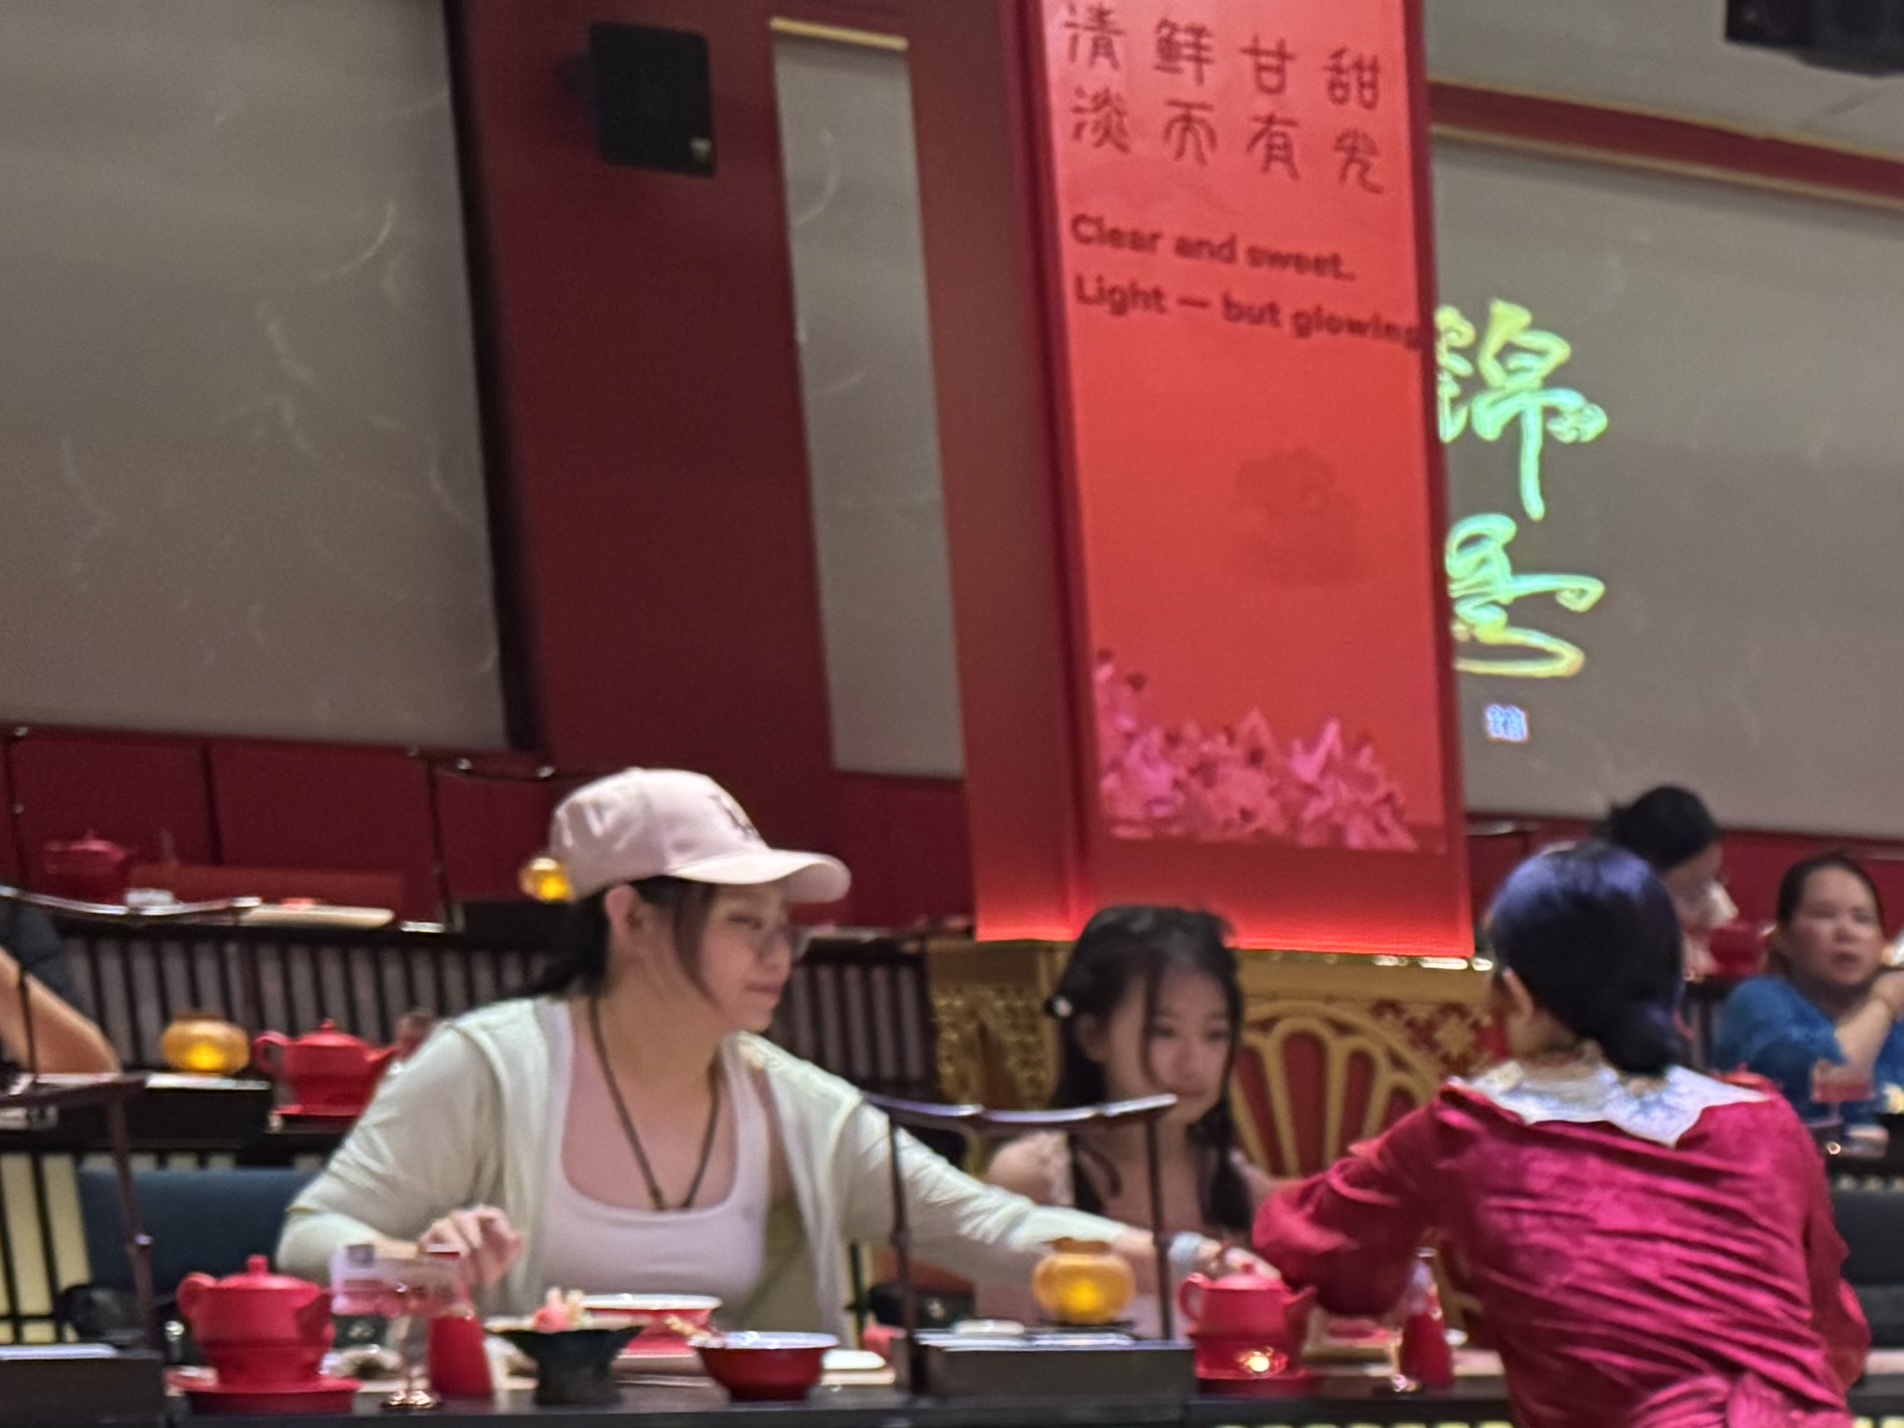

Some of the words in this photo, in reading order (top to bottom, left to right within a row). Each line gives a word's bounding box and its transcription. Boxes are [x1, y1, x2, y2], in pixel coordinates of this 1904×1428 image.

[1064, 3, 1381, 111] 清鲜甘甜
[1070, 212, 1162, 254] Clear
[1174, 232, 1237, 264] and
[1074, 271, 1165, 316] Light
[1221, 290, 1282, 329] but
